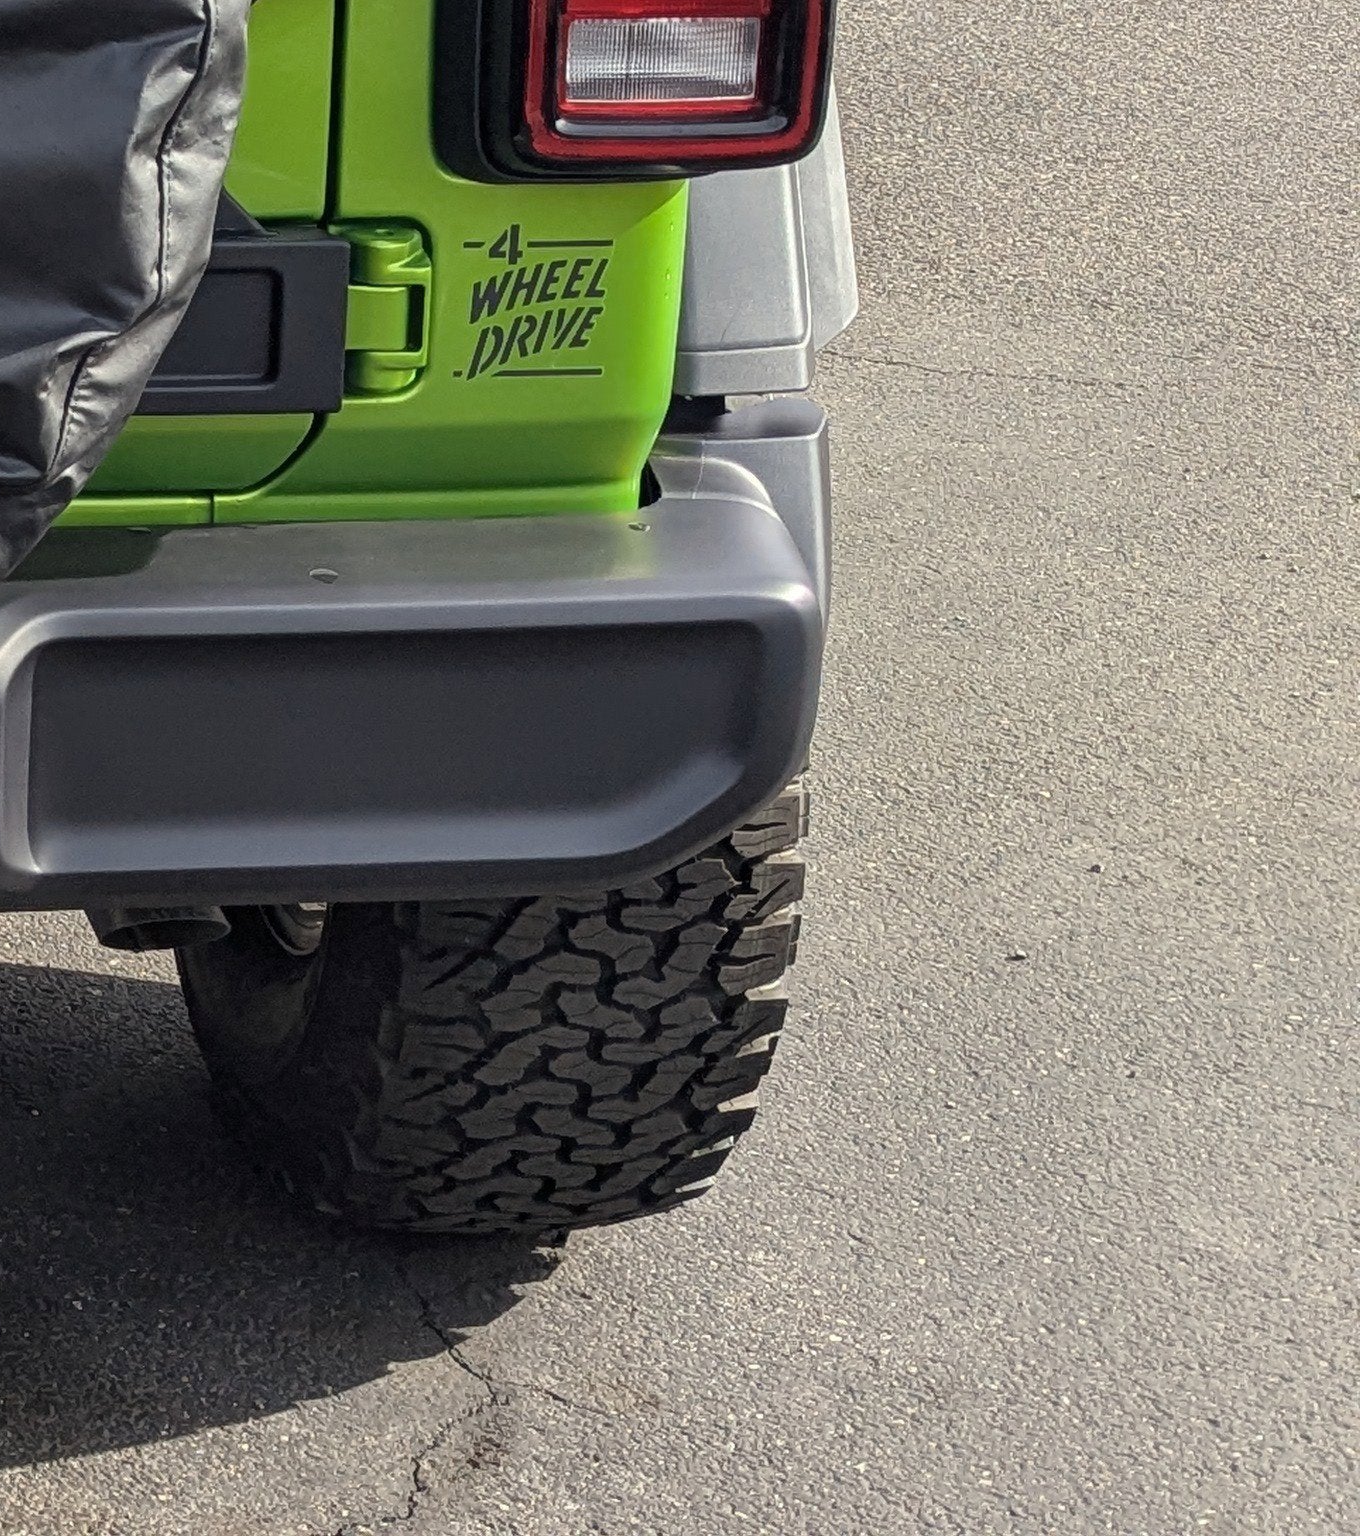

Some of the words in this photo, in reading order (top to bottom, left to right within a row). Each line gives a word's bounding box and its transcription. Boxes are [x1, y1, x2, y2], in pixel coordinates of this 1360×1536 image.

[488, 223, 523, 265] 4
[469, 258, 610, 324] WHEEL
[466, 306, 604, 381] DRIVE
